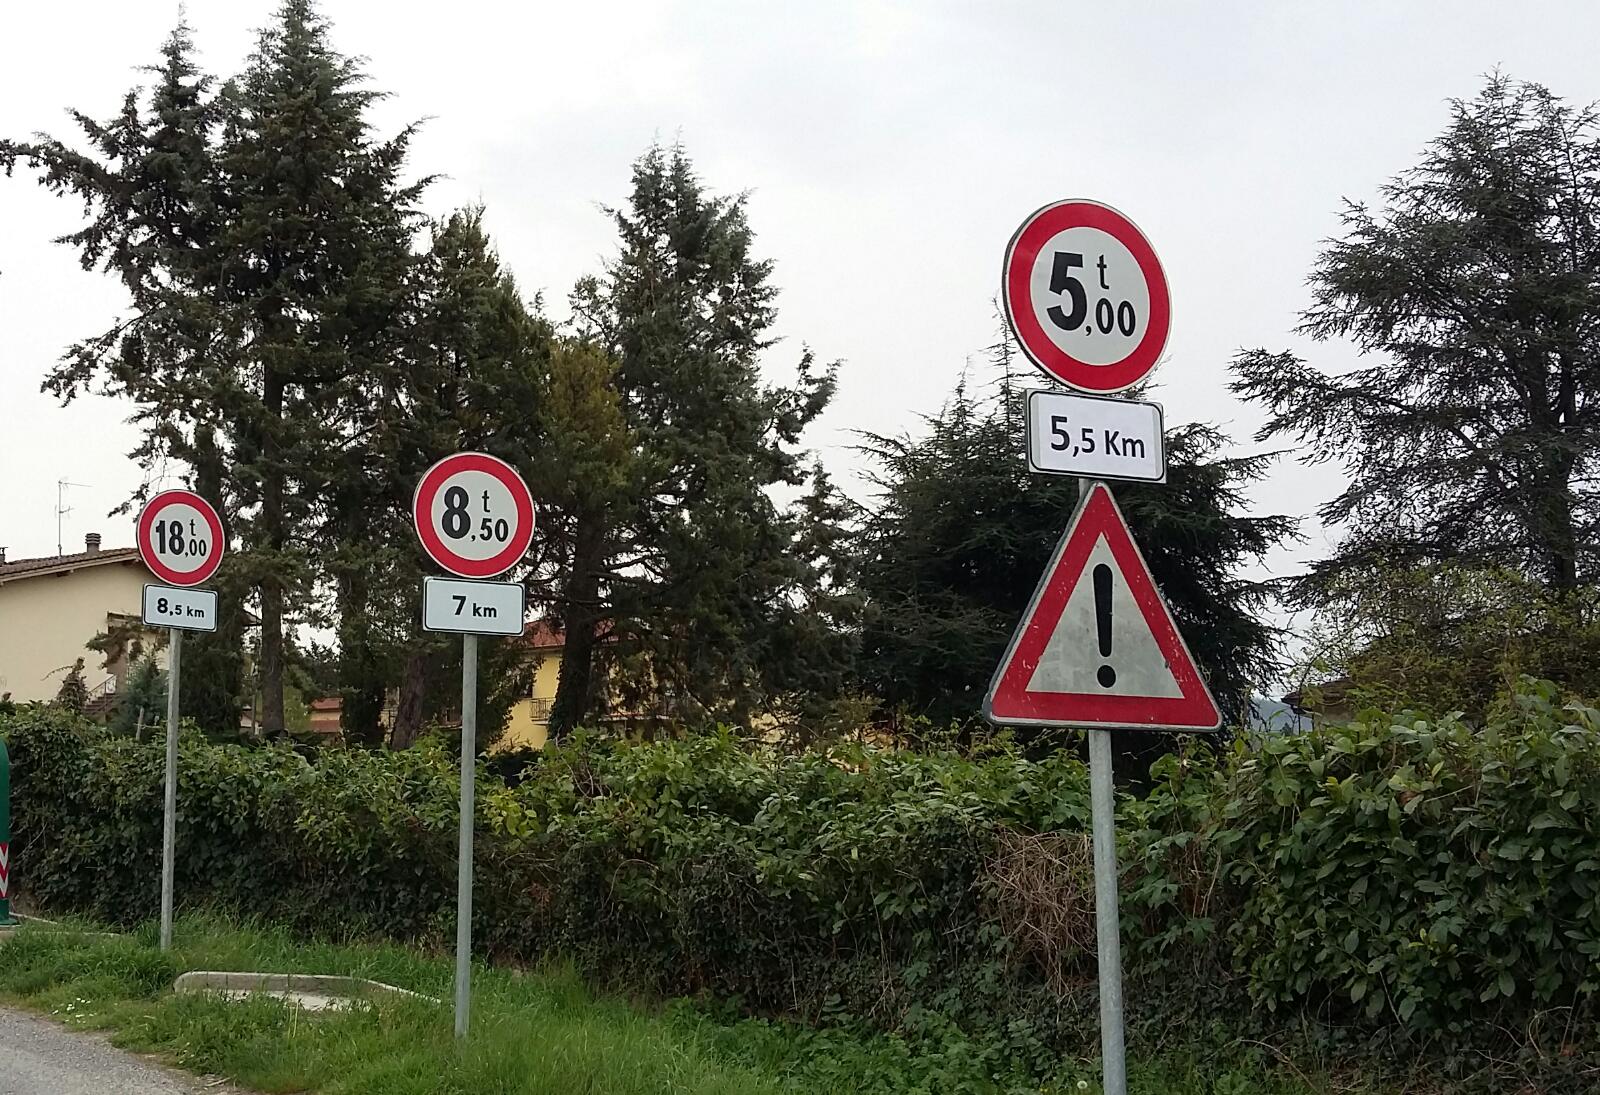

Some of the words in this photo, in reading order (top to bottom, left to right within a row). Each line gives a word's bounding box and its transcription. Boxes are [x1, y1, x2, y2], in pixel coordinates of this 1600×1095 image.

[1096, 254, 1110, 290] t
[1050, 415, 1095, 458] 5,5
[1104, 429, 1146, 459] Km
[481, 490, 491, 513] t
[189, 519, 197, 536] t
[157, 598, 183, 616] 8,5
[186, 605, 205, 618] km
[452, 594, 467, 616] 7
[472, 603, 497, 618] km
